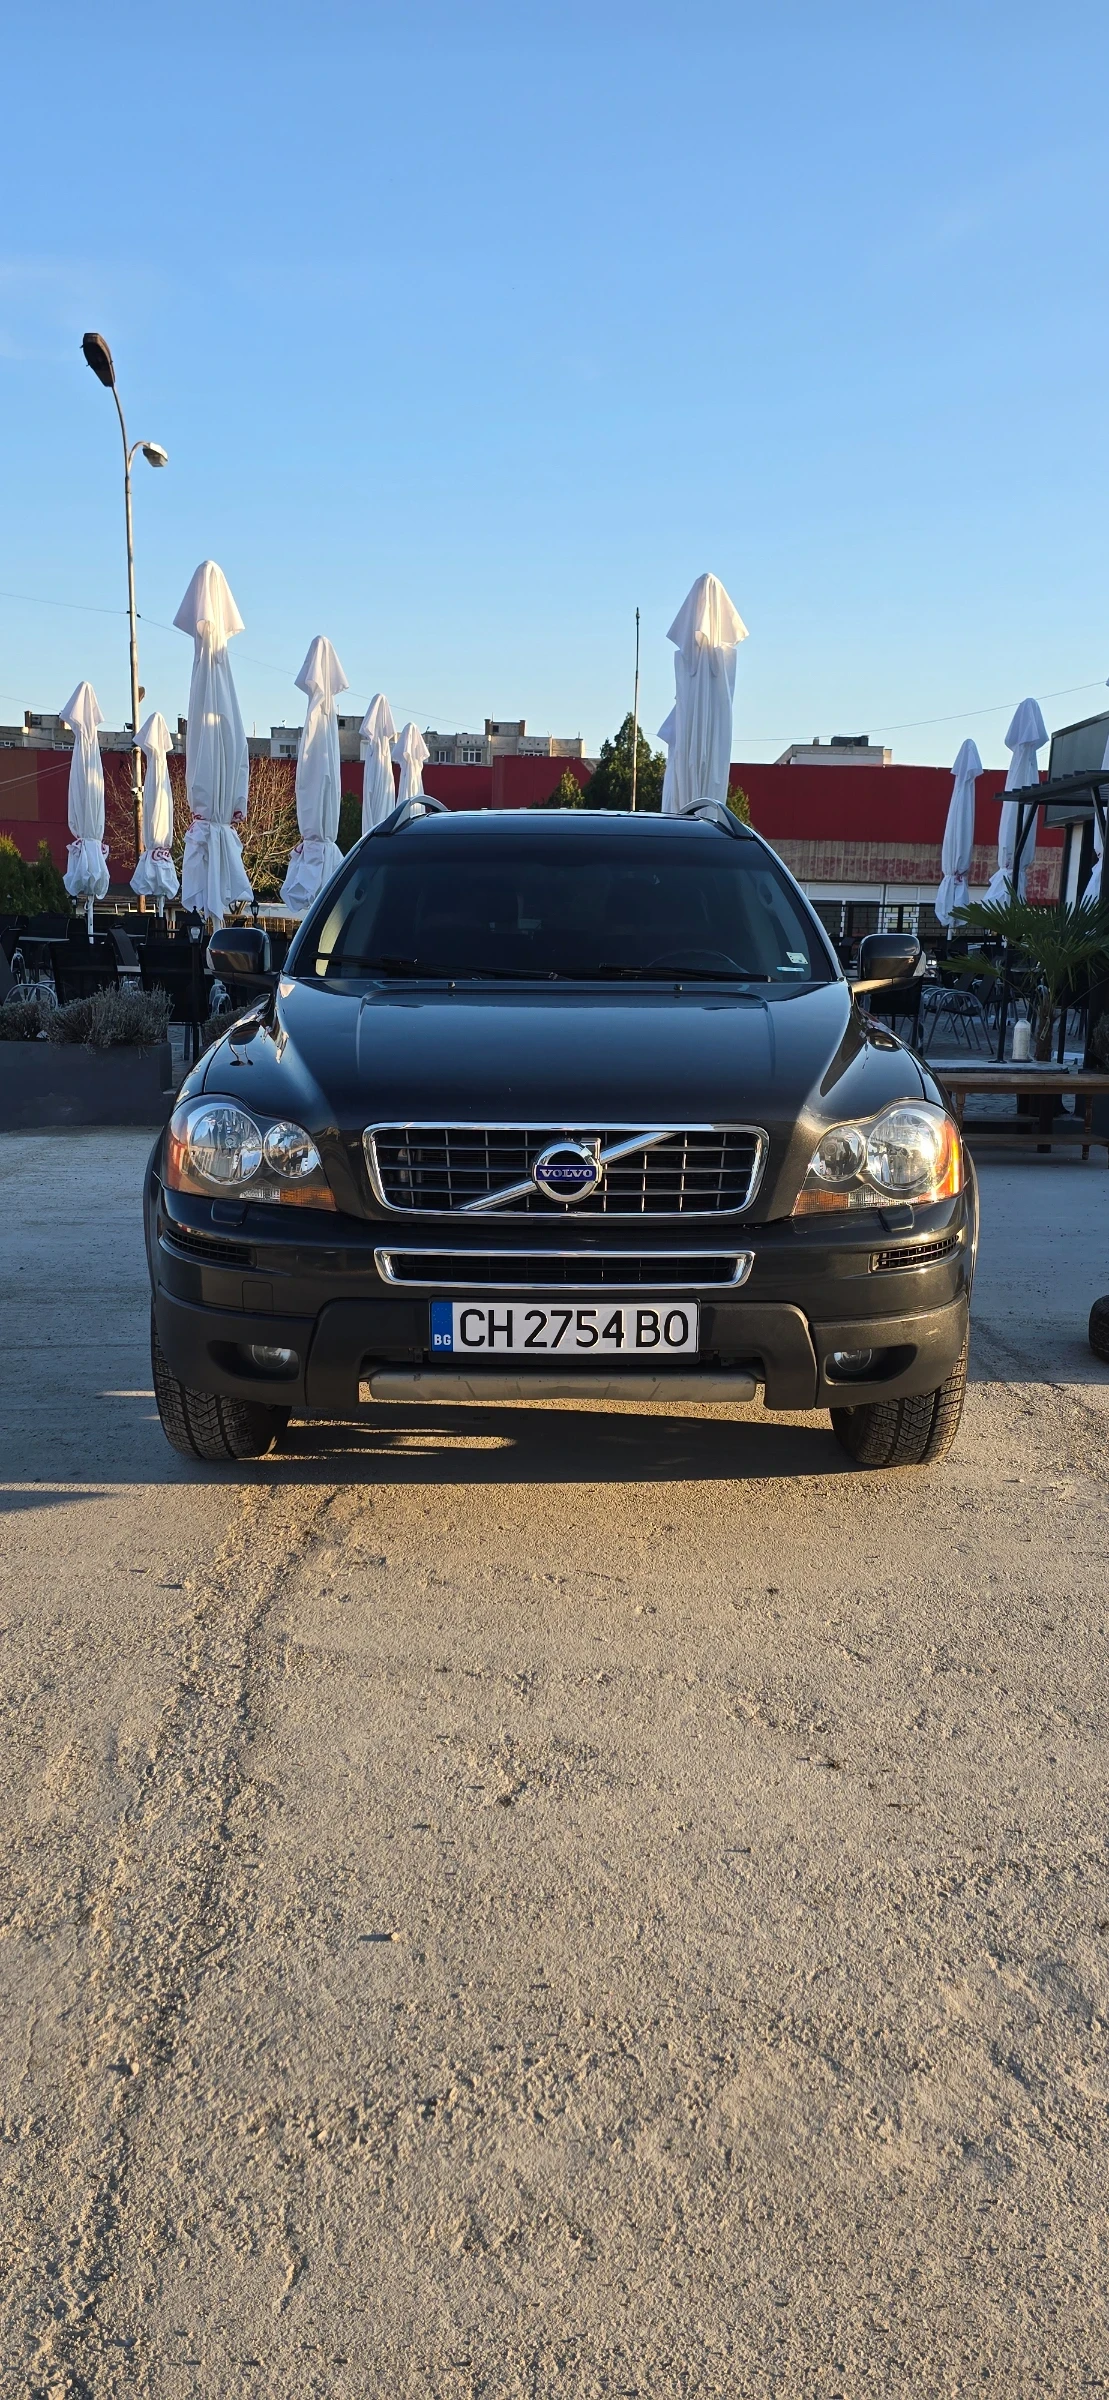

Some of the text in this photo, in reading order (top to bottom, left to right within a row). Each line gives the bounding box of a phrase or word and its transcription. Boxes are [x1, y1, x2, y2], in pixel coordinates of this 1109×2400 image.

[540, 1169, 593, 1177] VOLVO
[460, 1309, 689, 1348] CH 2754 BO
[434, 1335, 451, 1346] BG
